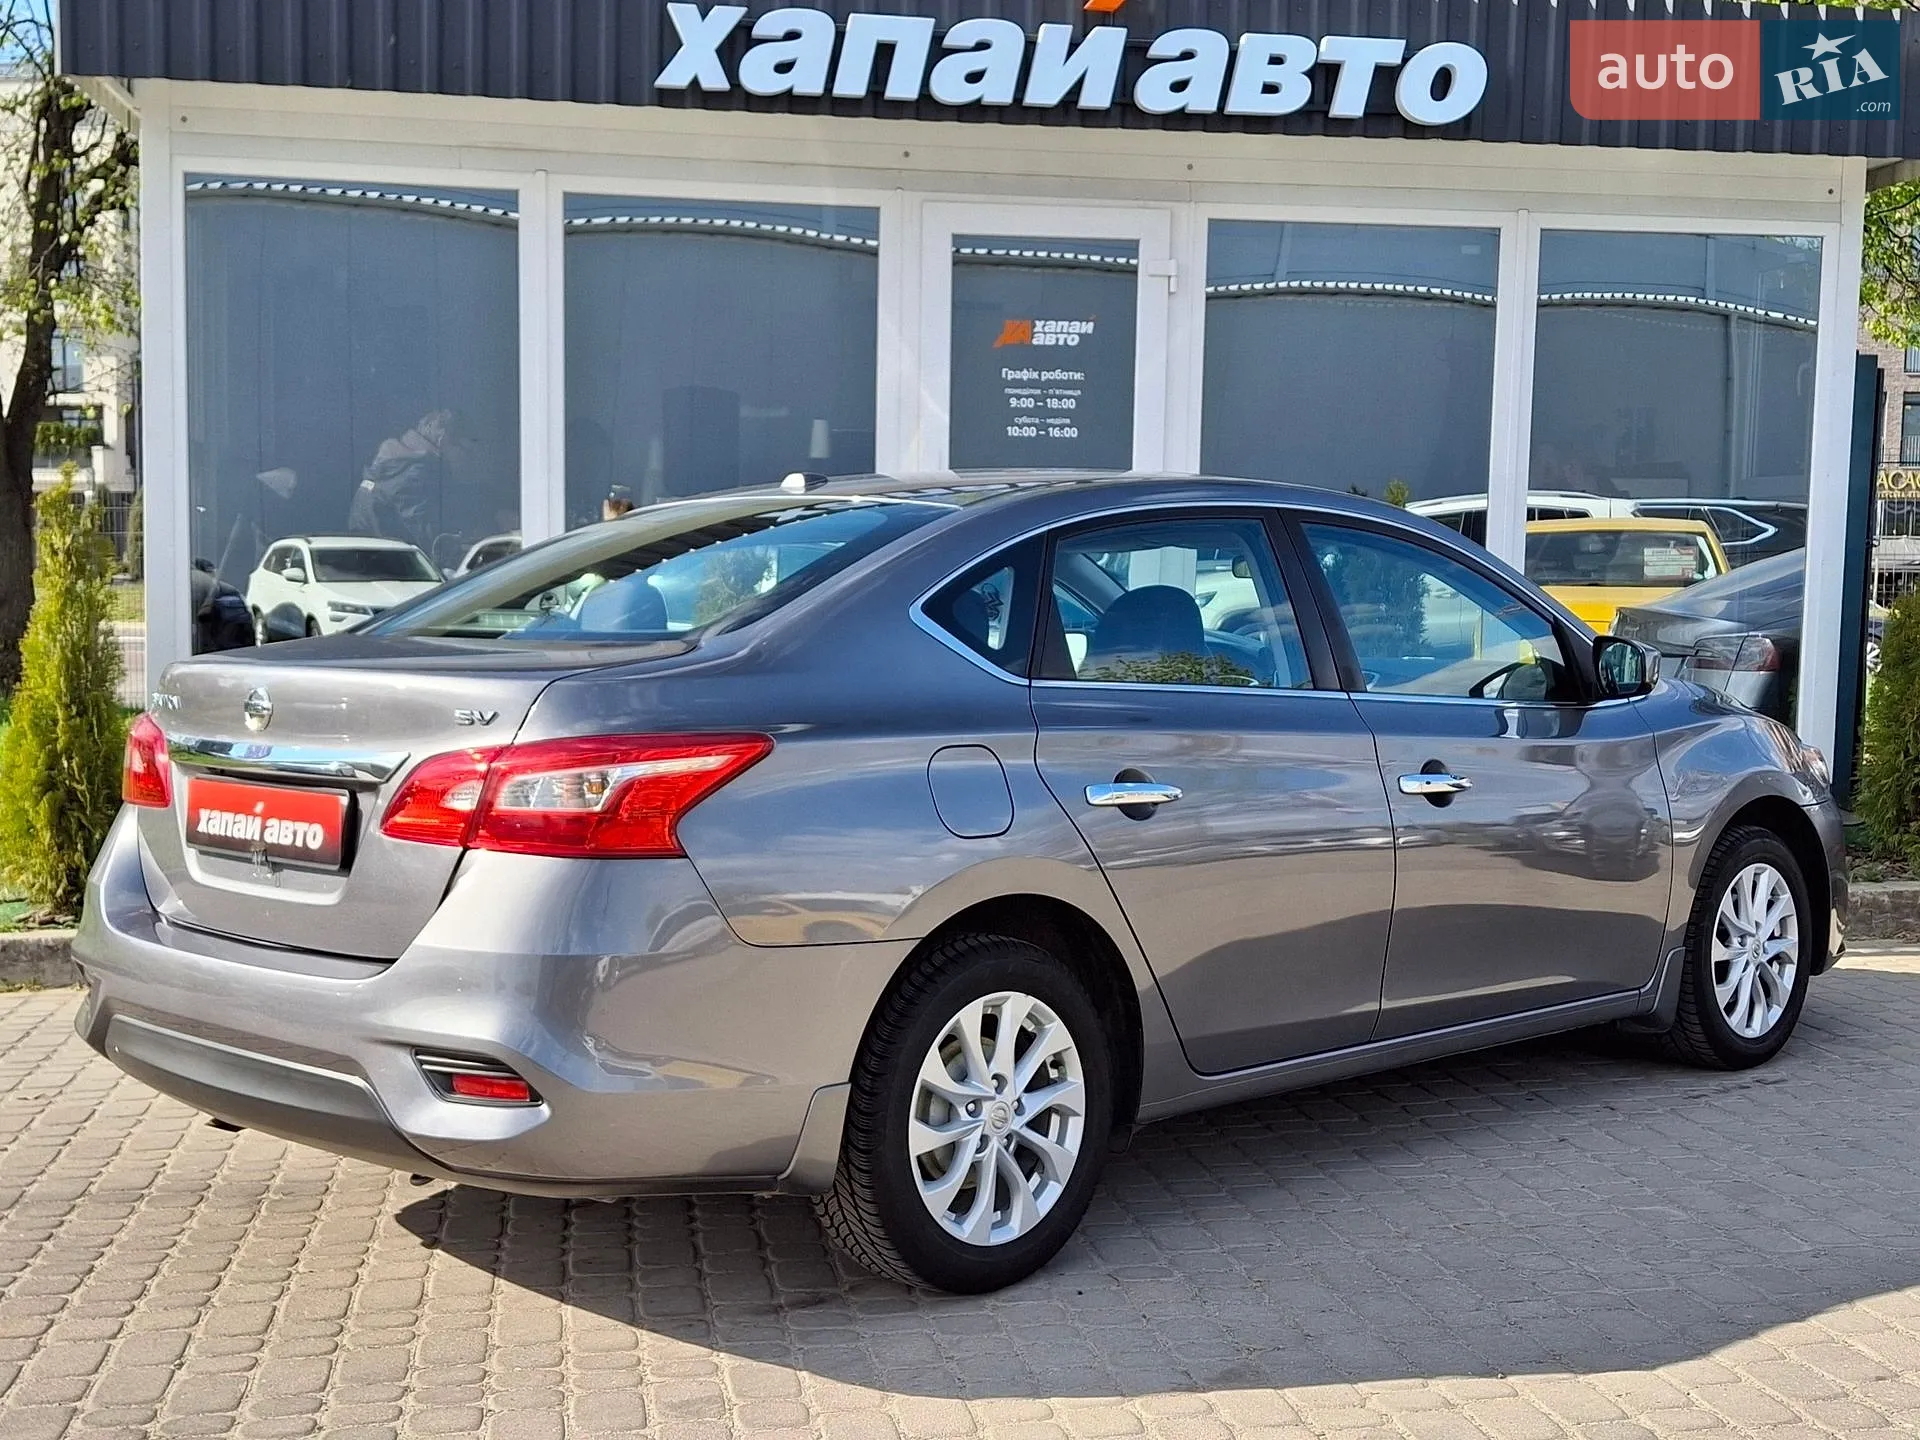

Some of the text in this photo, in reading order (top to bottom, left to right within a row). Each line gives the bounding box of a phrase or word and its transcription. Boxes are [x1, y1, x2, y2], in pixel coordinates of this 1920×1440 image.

[1133, 28, 1488, 126] авто
[1032, 333, 1080, 346] авто
[1001, 367, 1085, 381] Графік роботи:
[1009, 397, 1035, 408] 9:00
[1046, 398, 1076, 409] 18:00
[1006, 426, 1037, 437] 10:00
[1047, 427, 1078, 438] 16:00
[454, 708, 499, 726] SV
[197, 801, 324, 850] хапай авто
